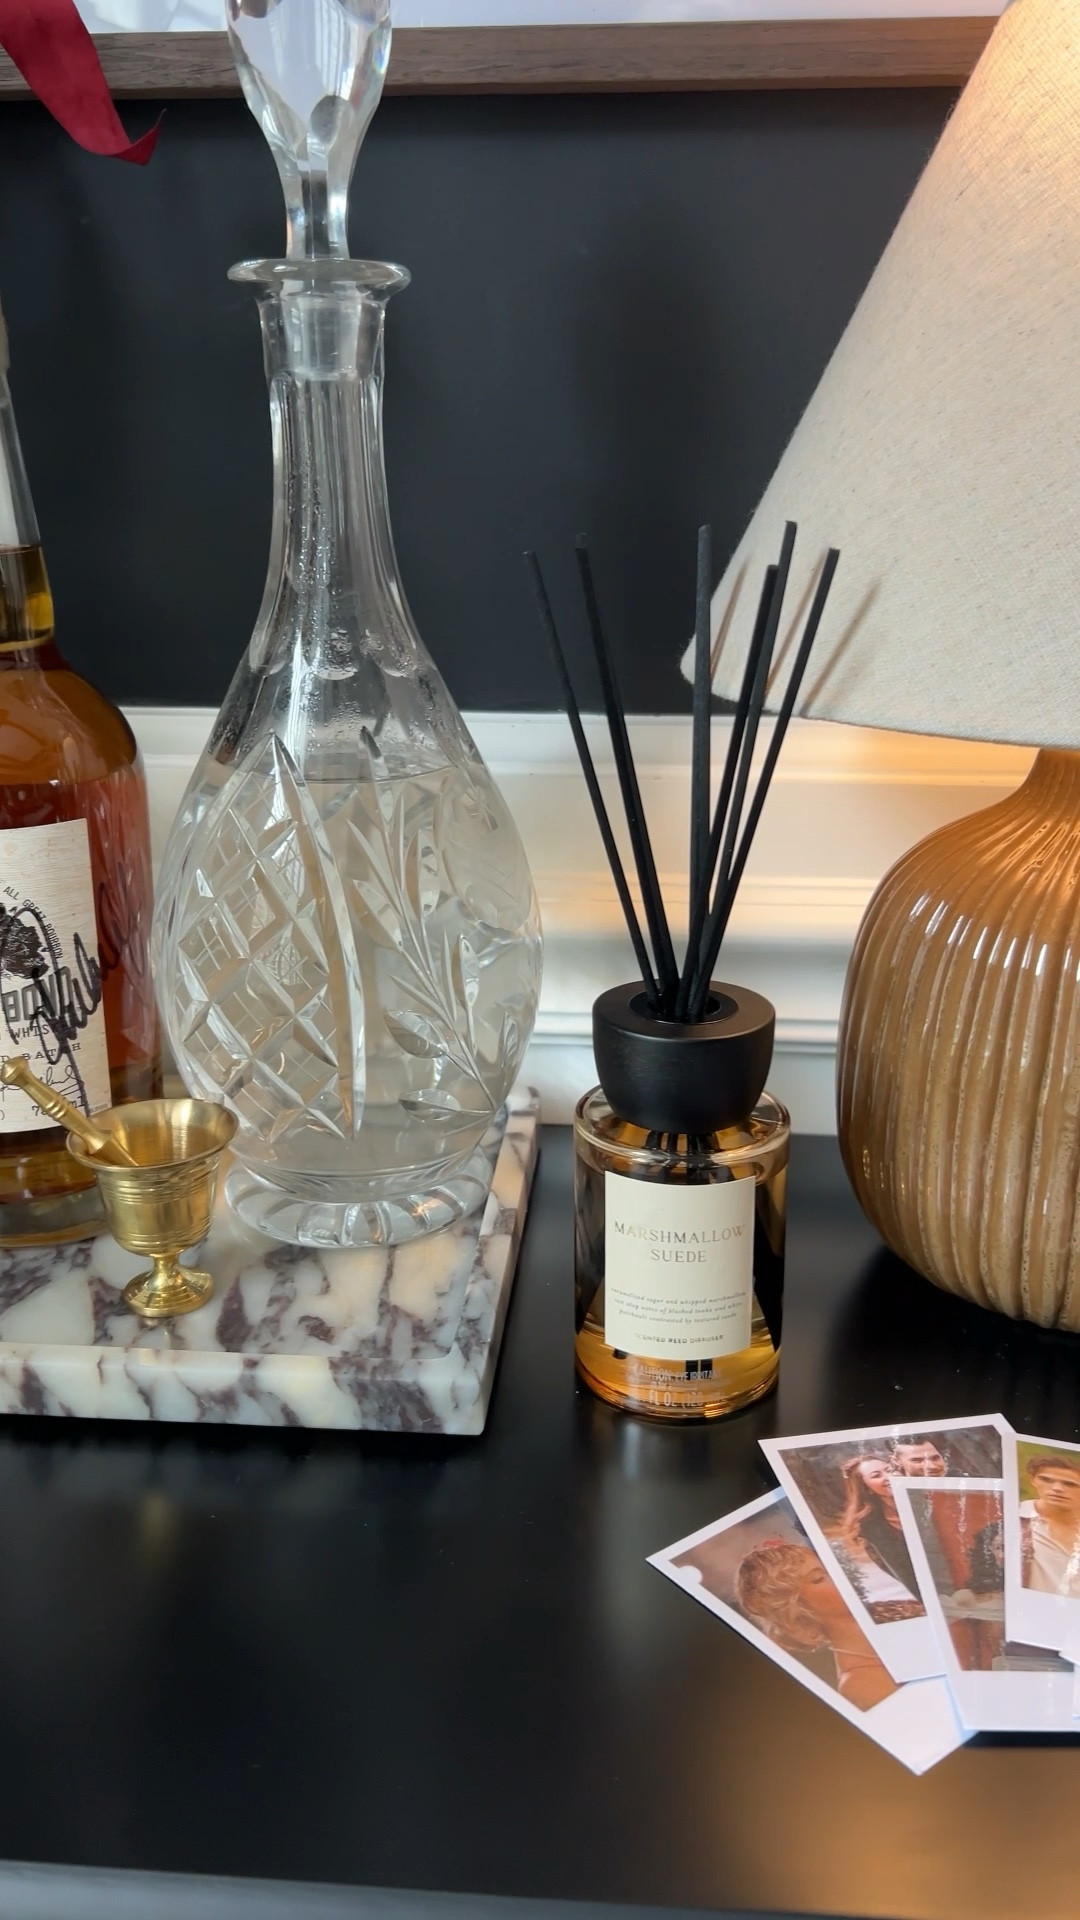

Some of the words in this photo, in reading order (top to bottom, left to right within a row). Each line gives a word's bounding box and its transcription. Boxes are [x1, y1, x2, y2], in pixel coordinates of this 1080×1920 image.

[3, 886, 20, 901] ALL
[45, 923, 63, 959] BOURBON
[21, 1043, 81, 1061] BATH
[614, 1221, 746, 1244] MARSHMALLOW
[650, 1249, 707, 1263] SUEDE
[680, 1298, 706, 1306] whipped
[714, 1304, 726, 1312] and
[634, 1332, 666, 1343] SCENTED
[689, 1334, 724, 1344] DIFFUSER
